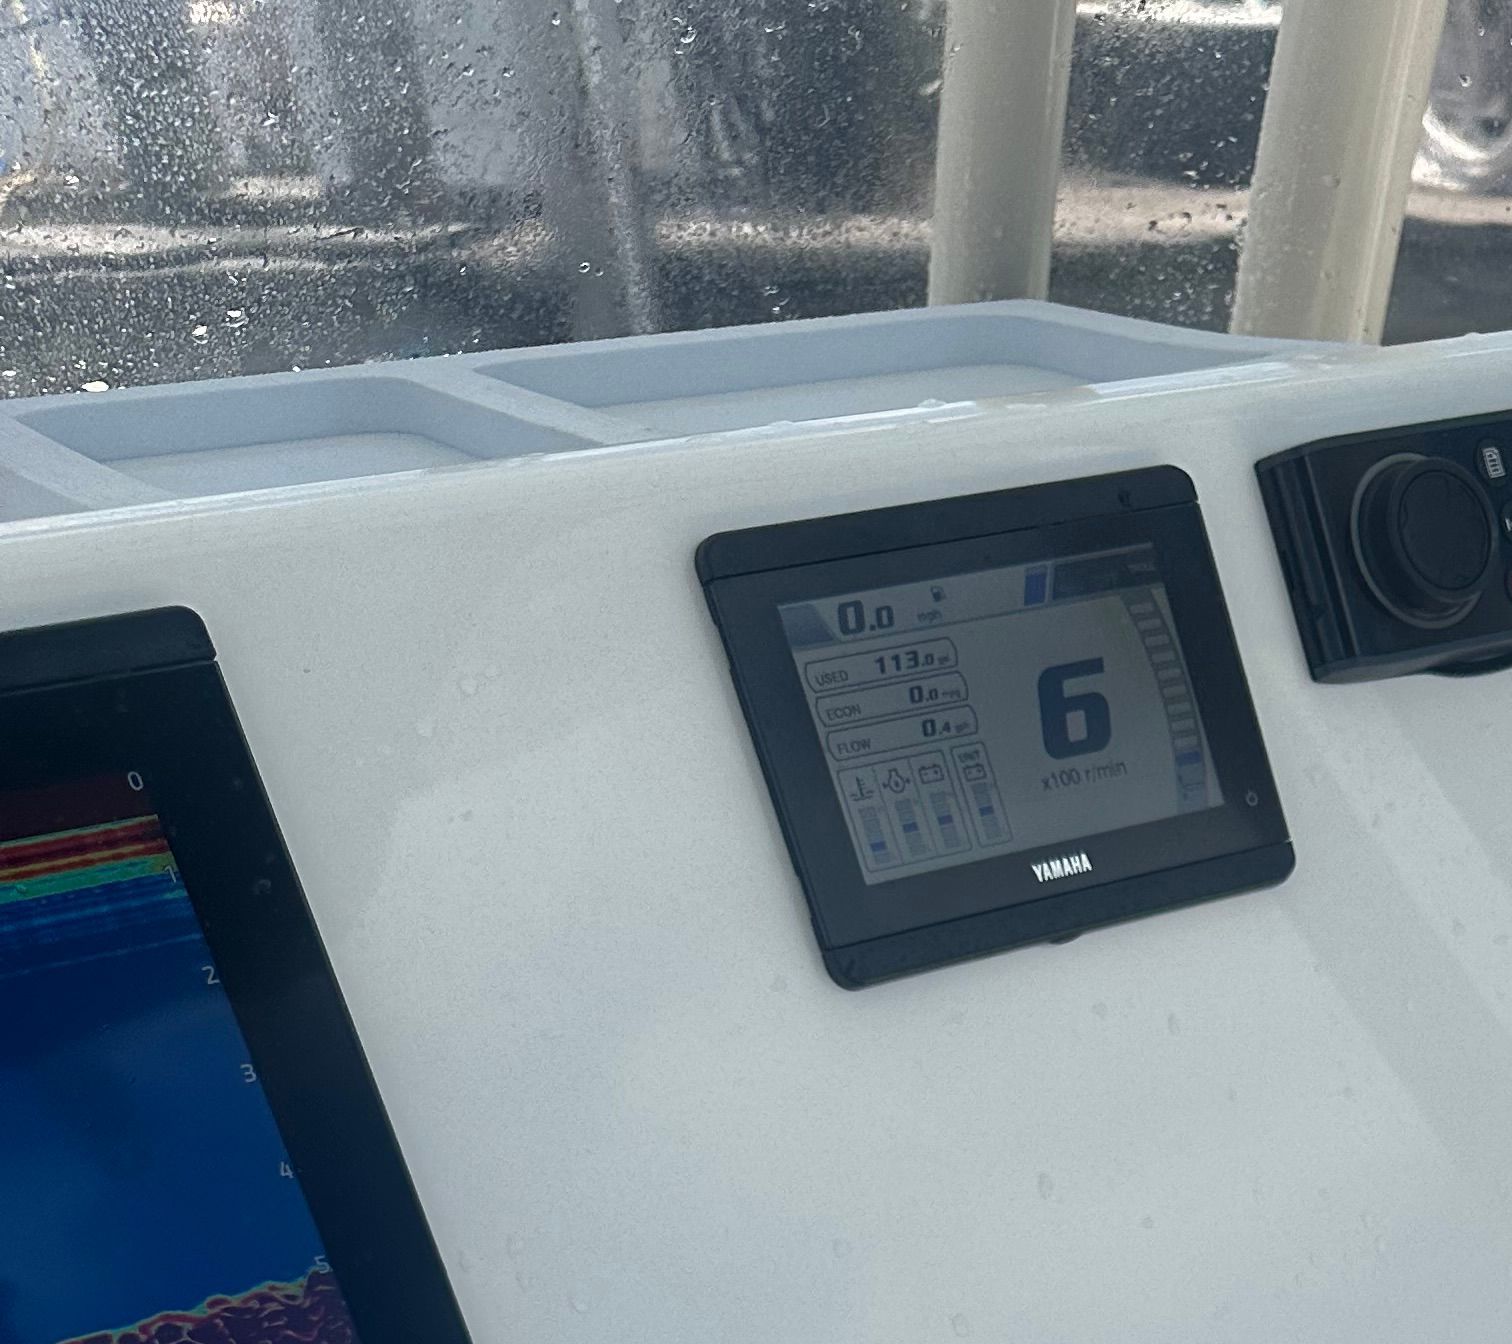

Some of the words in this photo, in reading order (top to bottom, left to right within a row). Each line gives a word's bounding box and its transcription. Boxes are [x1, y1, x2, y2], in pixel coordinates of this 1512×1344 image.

[838, 600, 894, 635] 0.0
[815, 668, 849, 686] USED
[874, 649, 935, 675] 113.0
[826, 703, 861, 721] ECON
[909, 684, 939, 705] 0.0
[1037, 657, 1111, 759] 6
[837, 737, 872, 755] FLOW
[921, 717, 952, 738] 0.4
[127, 770, 143, 791] 0
[1041, 767, 1081, 790] x100
[1084, 759, 1127, 783] r/min
[1032, 853, 1093, 883] YAMAHA
[202, 965, 220, 986] 2
[240, 1063, 257, 1084] 3
[279, 1161, 294, 1181] 4
